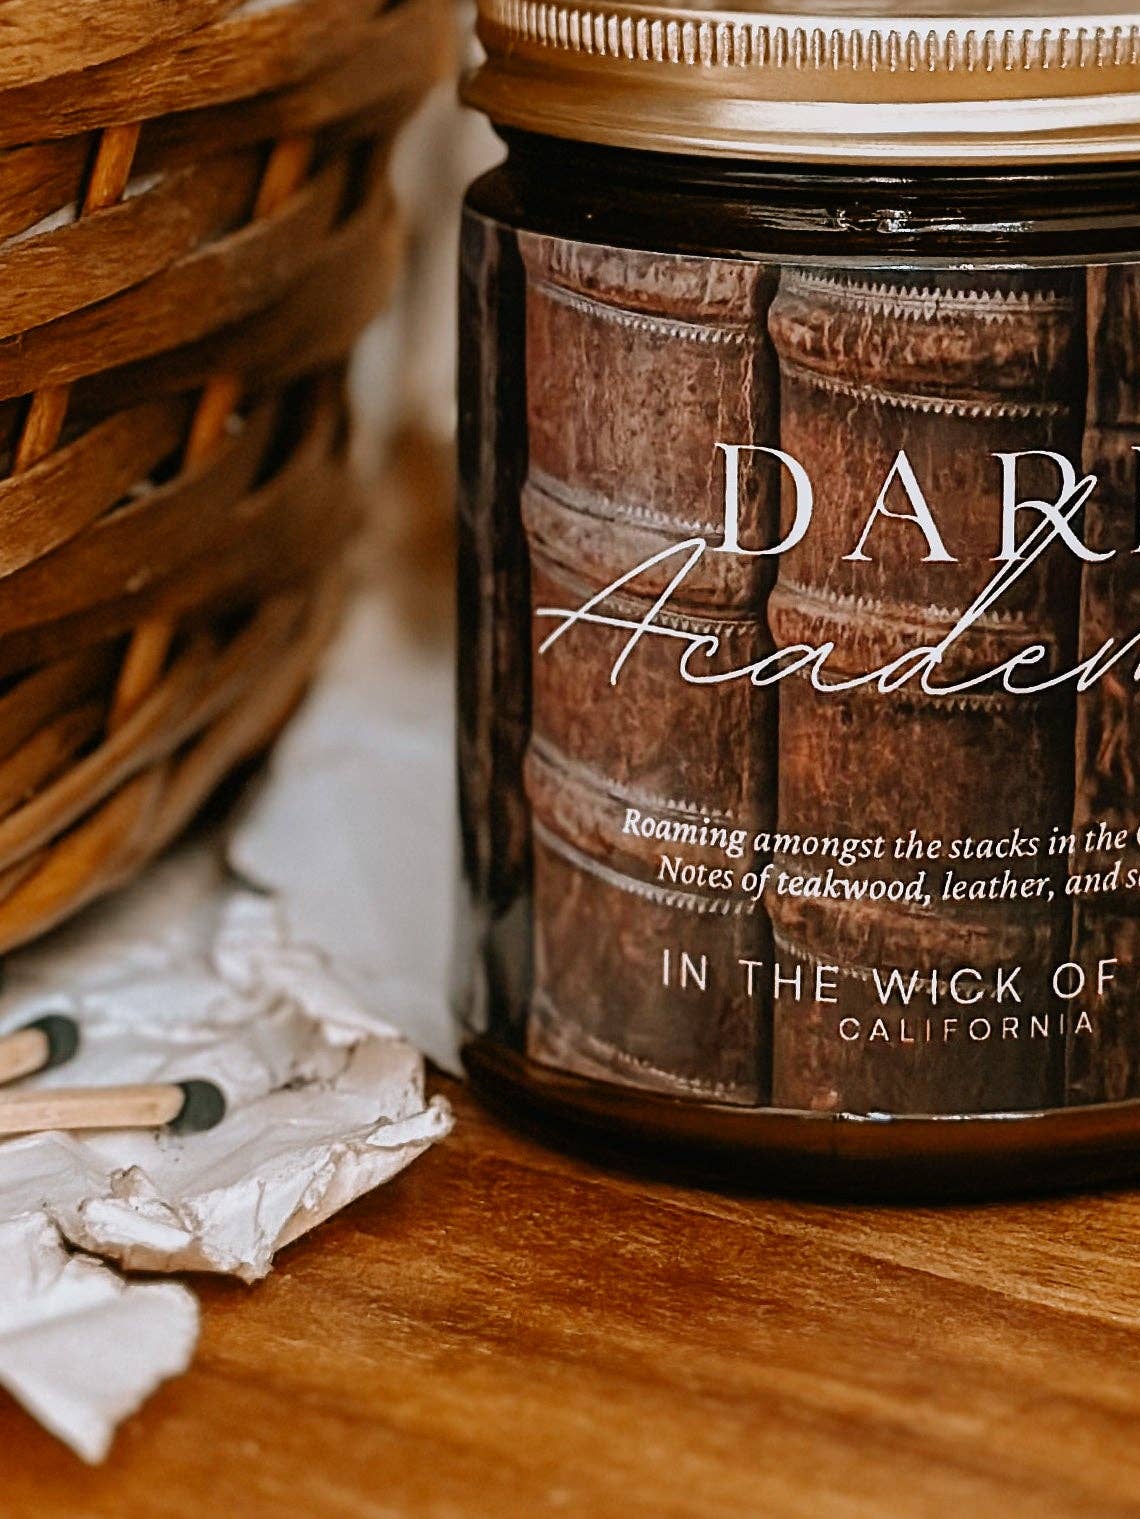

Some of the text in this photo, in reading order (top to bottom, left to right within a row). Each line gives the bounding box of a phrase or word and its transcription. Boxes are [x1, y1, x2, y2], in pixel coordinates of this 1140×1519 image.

[622, 808, 747, 859] Roaming
[753, 832, 886, 867] amongst
[894, 829, 942, 860] the
[948, 828, 1040, 860] stacks
[1048, 826, 1077, 857] in
[1084, 822, 1128, 853] the
[658, 854, 734, 890] Notes
[741, 863, 775, 902] of
[777, 868, 932, 907] teakwood,
[942, 869, 1056, 903] leather,
[1064, 861, 1121, 896] and
[661, 948, 707, 992] IN
[737, 958, 840, 1004] THE
[872, 966, 1023, 1006] WICK
[1052, 957, 1119, 1000] OF
[838, 1011, 1094, 1042] CALIFORNIA
